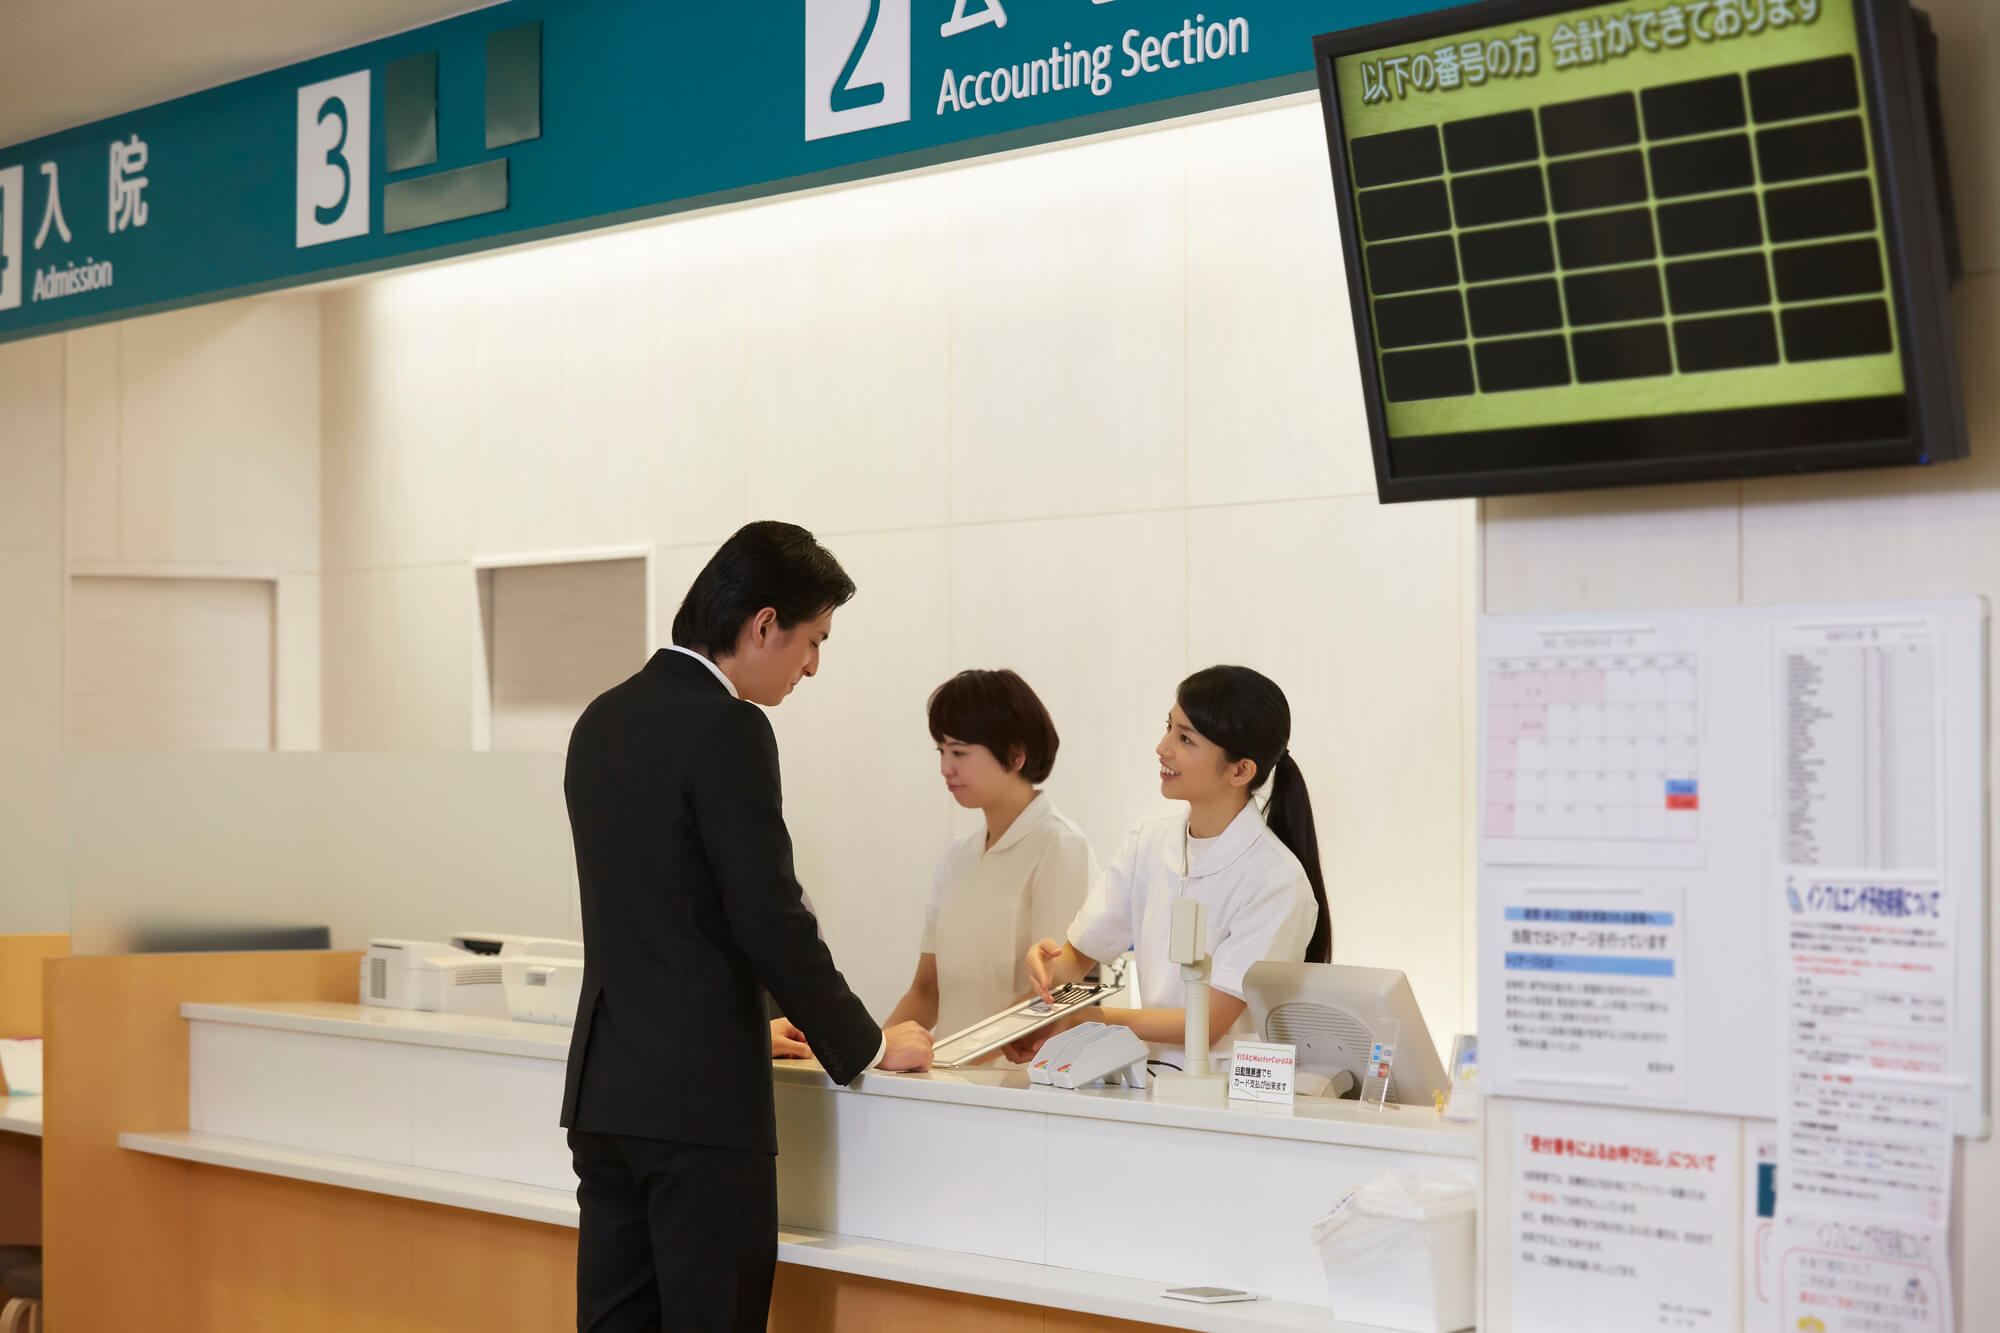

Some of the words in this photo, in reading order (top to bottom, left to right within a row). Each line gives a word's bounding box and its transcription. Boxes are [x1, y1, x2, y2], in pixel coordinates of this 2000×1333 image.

[829, 0, 886, 113] 2
[936, 41, 1113, 115] Accounting
[1121, 14, 1249, 78] Section
[1361, 33, 1538, 102] 以下の番号の方
[1551, 0, 1821, 67] 会計ができております
[34, 134, 149, 250] 入院
[314, 96, 351, 226] 3
[32, 257, 113, 302] Admission
